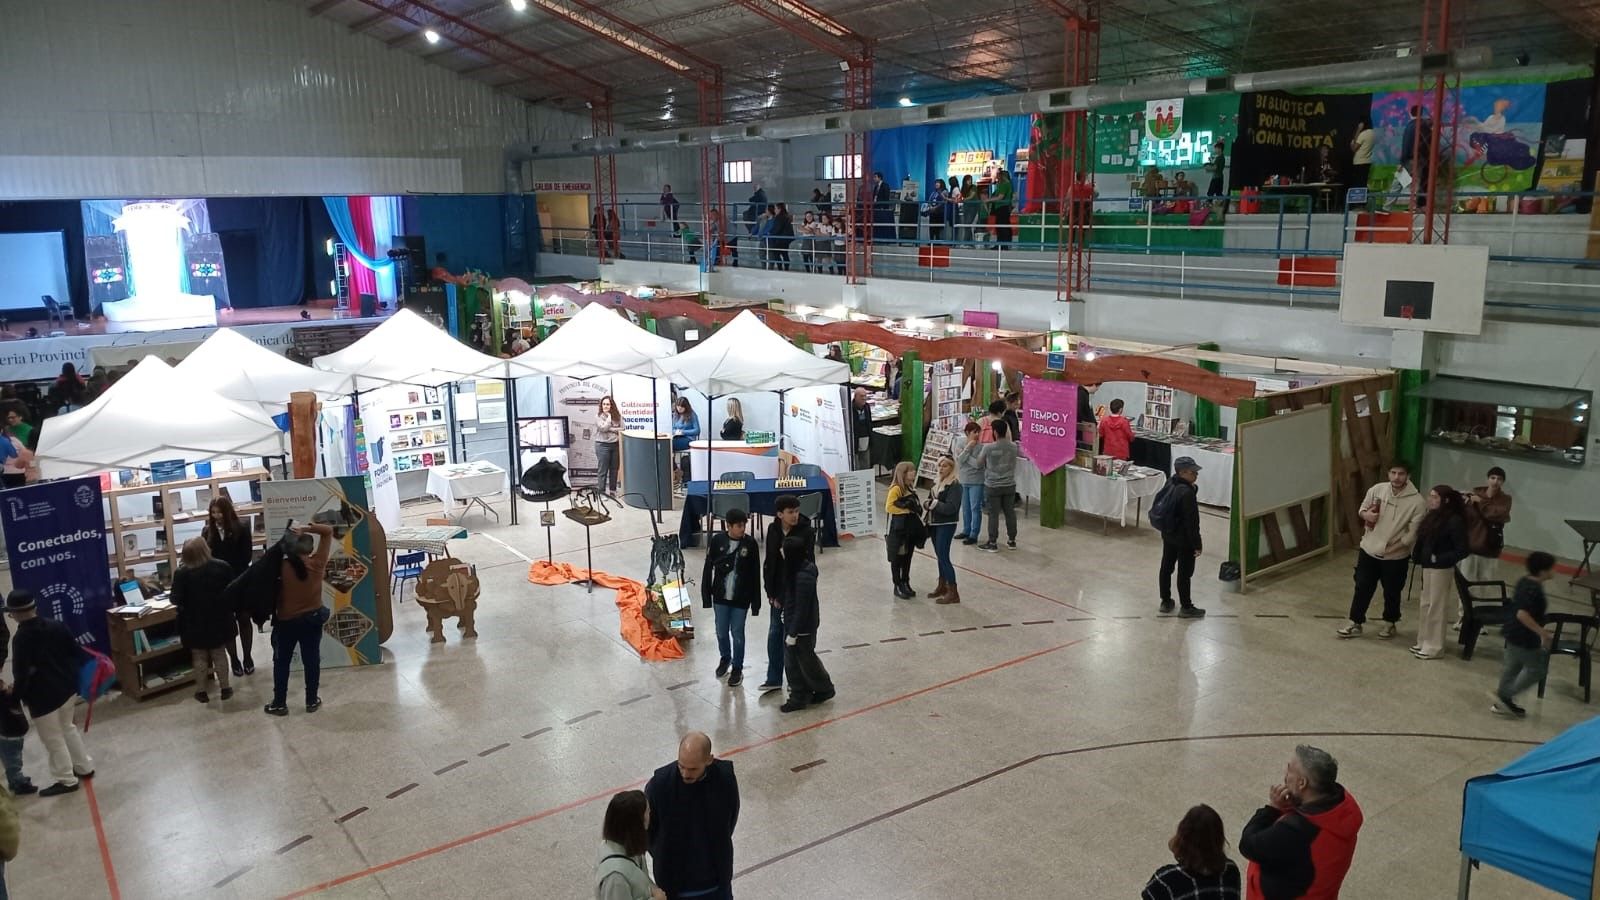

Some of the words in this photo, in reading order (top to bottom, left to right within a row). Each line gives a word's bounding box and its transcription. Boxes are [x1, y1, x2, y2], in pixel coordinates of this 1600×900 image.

[1255, 94, 1325, 115] BIBLIOTECA
[1259, 113, 1306, 132] POPULAR
[1029, 408, 1060, 422] TIEMPO
[1062, 413, 1069, 423] Y
[1030, 422, 1066, 437] ESPACIO
[266, 494, 317, 505] Bienvenidos
[17, 528, 102, 553] Conectados,
[20, 556, 46, 570] con
[48, 550, 76, 564] vos.
